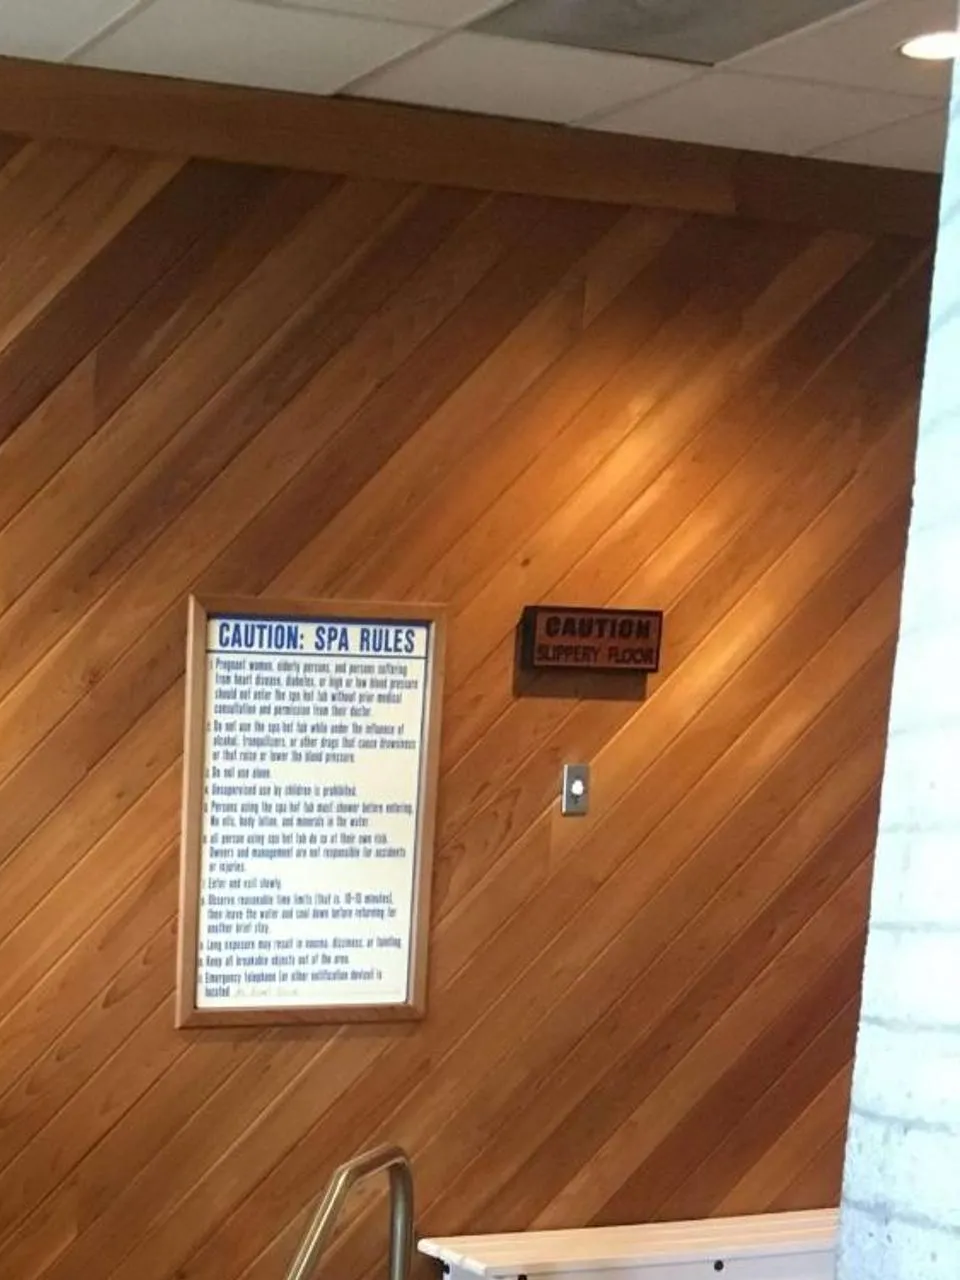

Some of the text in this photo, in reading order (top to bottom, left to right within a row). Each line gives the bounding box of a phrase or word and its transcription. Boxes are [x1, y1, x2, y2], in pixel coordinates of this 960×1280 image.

[218, 622, 415, 653] CAUTION: SPA RULES
[545, 616, 651, 639] CAUTION
[537, 644, 653, 664] SLIPPERY FLOOR
